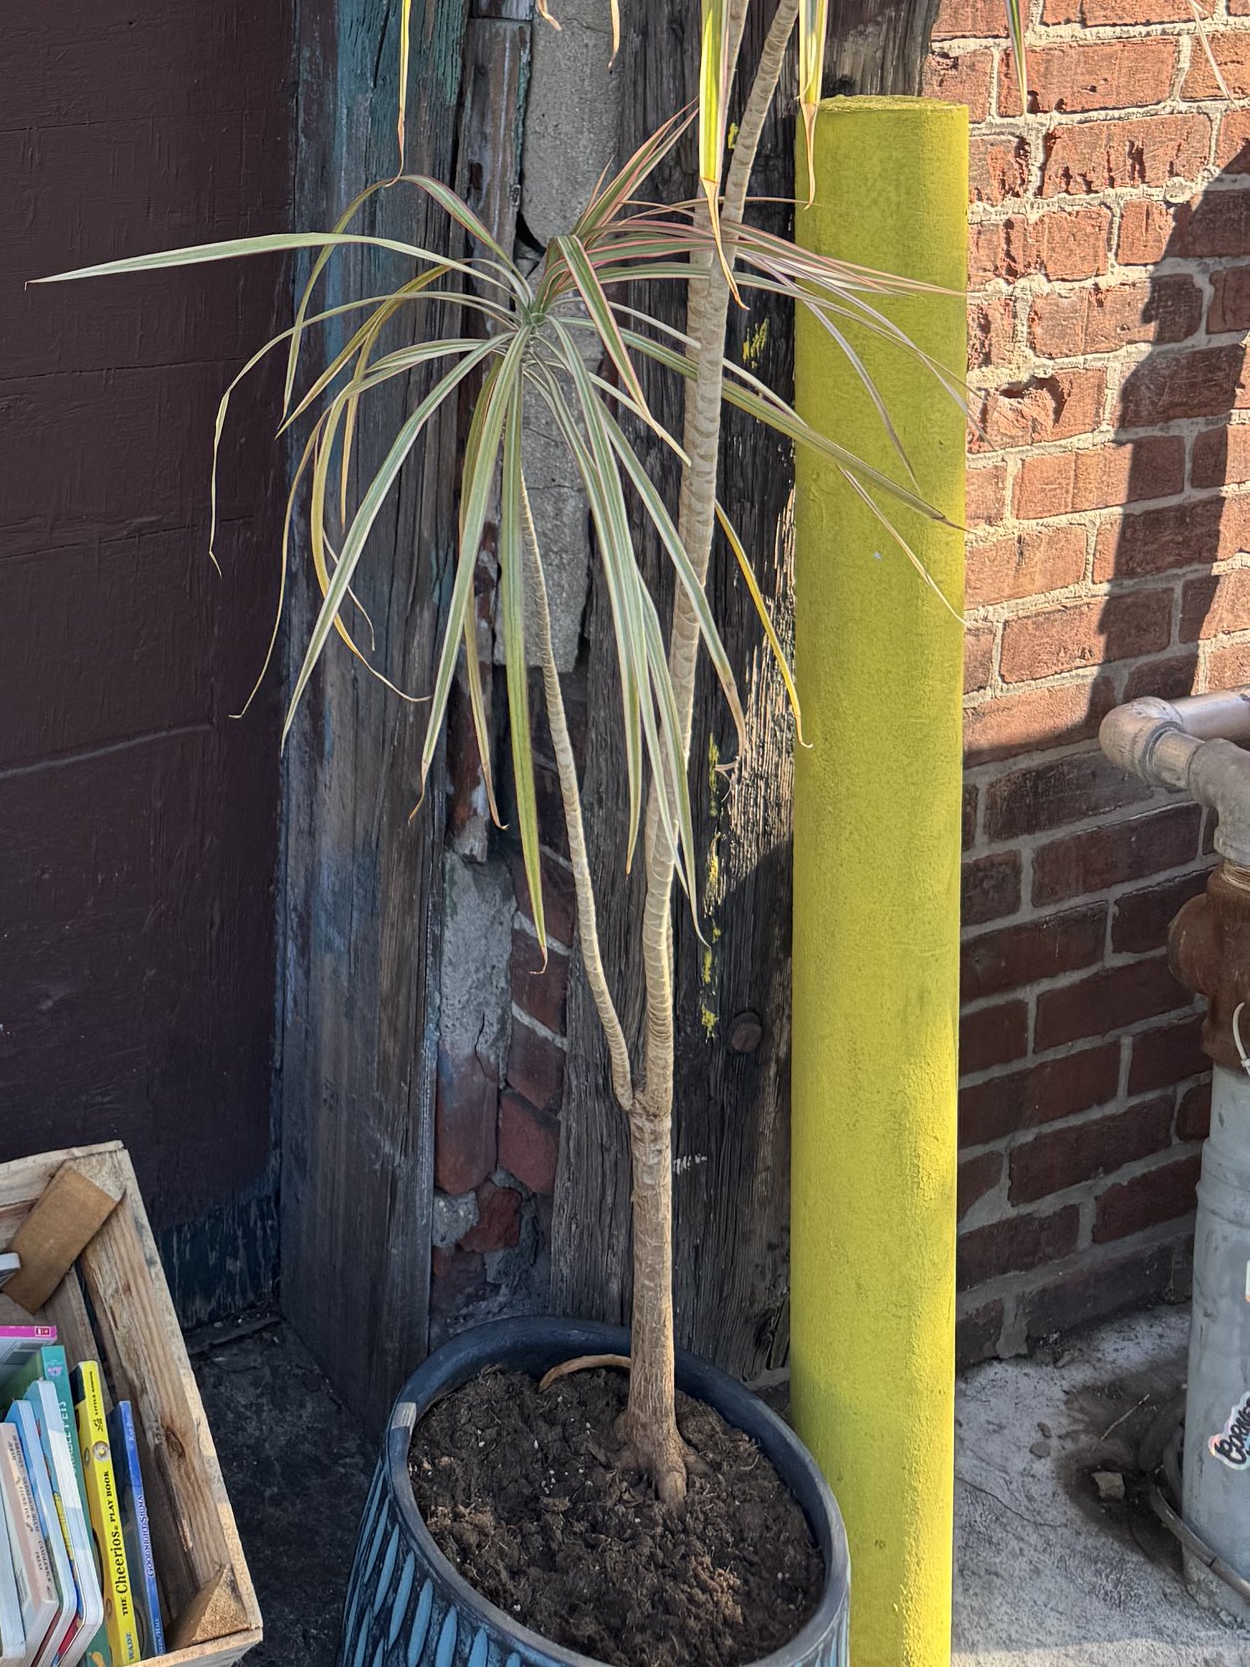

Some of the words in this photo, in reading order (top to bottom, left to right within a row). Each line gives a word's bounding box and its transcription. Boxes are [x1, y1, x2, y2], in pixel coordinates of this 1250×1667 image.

[103, 1470, 114, 1497] BOOK
[107, 1499, 116, 1523] PLAY
[121, 1596, 129, 1617] THE
[125, 1632, 136, 1661] WADE
